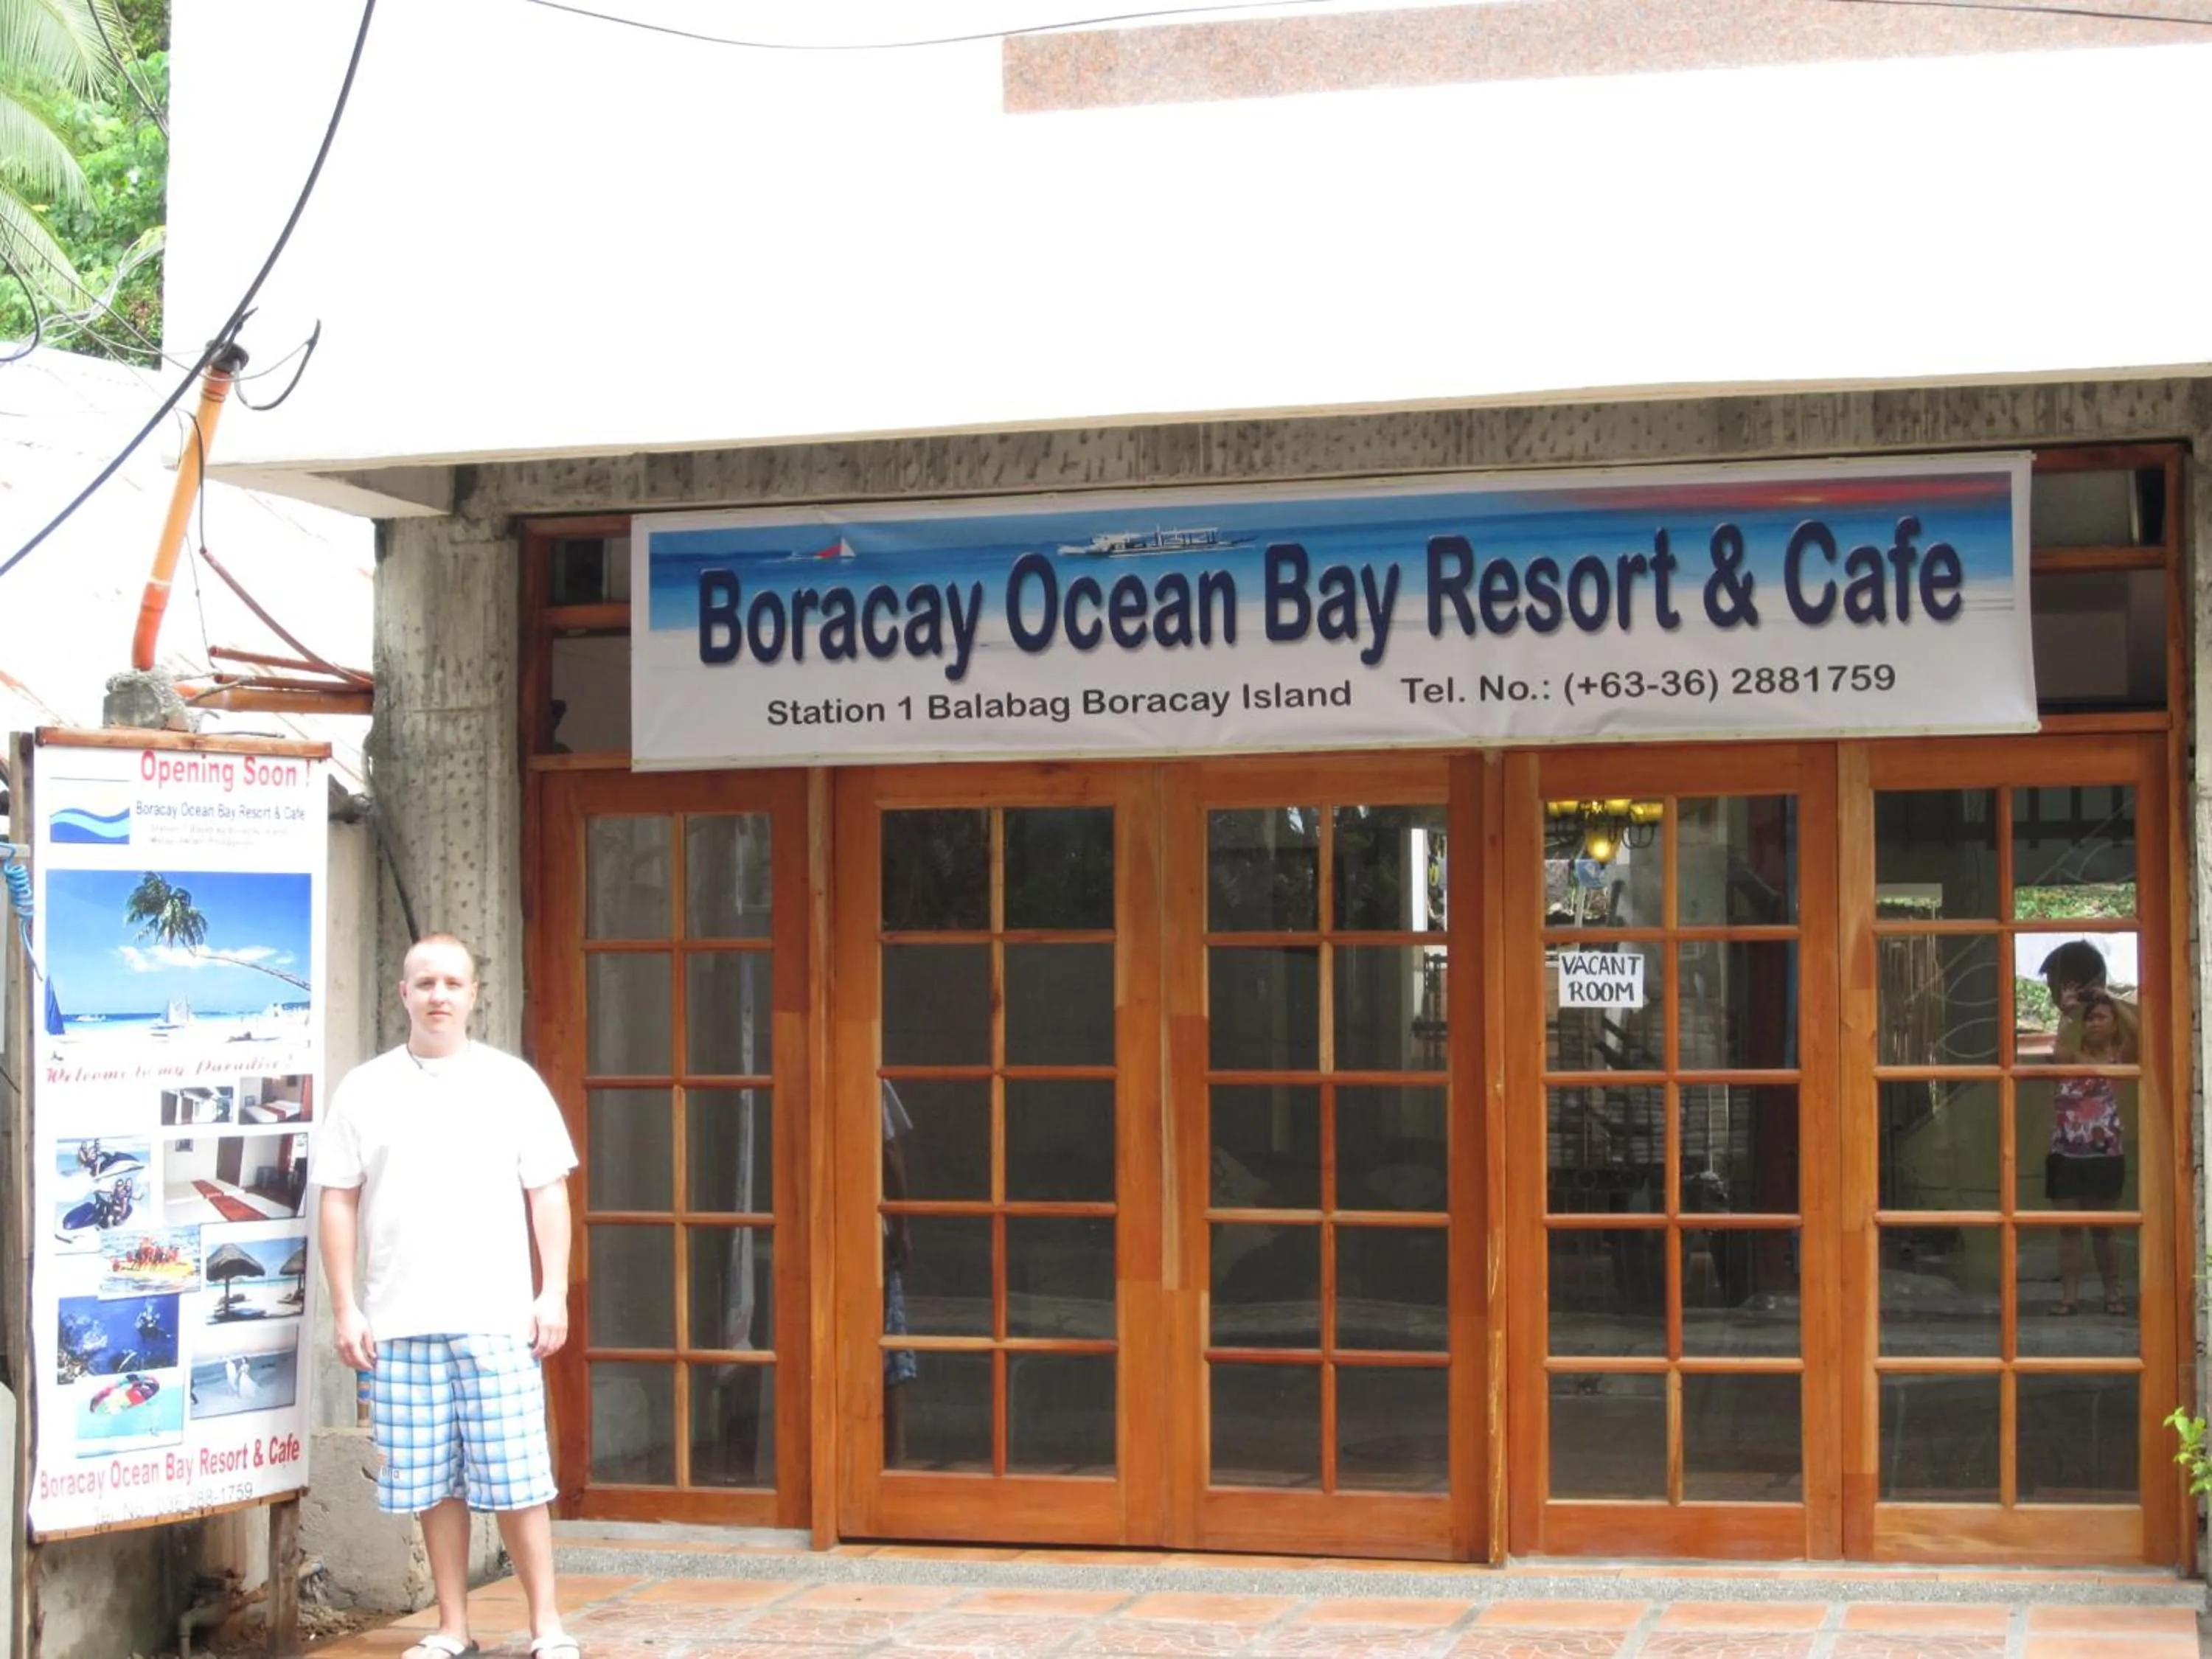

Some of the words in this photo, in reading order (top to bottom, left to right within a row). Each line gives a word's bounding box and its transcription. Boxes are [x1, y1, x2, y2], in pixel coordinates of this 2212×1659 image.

[699, 568, 984, 680] Boracay
[1005, 552, 1237, 652] Ocean
[1264, 543, 1400, 666] Bay
[1427, 526, 1680, 637] Resort
[1703, 523, 1759, 628] &
[1784, 515, 1963, 625] Cafe
[767, 698, 885, 726] Station
[898, 697, 913, 722] 1
[928, 692, 1071, 723] Balabag
[1083, 686, 1231, 717] Boracay
[1243, 680, 1351, 710] Island
[1401, 675, 1467, 705] Tel.
[1479, 674, 1551, 703] No.:
[1564, 669, 1719, 707] (+63-36)
[1731, 664, 1897, 696] 2881759
[140, 749, 234, 792] Opening
[243, 756, 296, 787] Soon
[136, 800, 177, 819] Boracay
[181, 801, 215, 818] Ocean
[218, 803, 236, 820] Bay
[238, 804, 271, 820] Resort
[1562, 955, 1641, 975] VACANT
[1568, 981, 1635, 1002] ROOM
[46, 1067, 126, 1084] Welcome
[40, 1470, 106, 1500] Boracay
[111, 1460, 159, 1489] Ocean
[165, 1453, 194, 1485] Bay
[199, 1442, 248, 1475] Resort
[253, 1439, 263, 1467] &
[268, 1433, 301, 1464] Cafe
